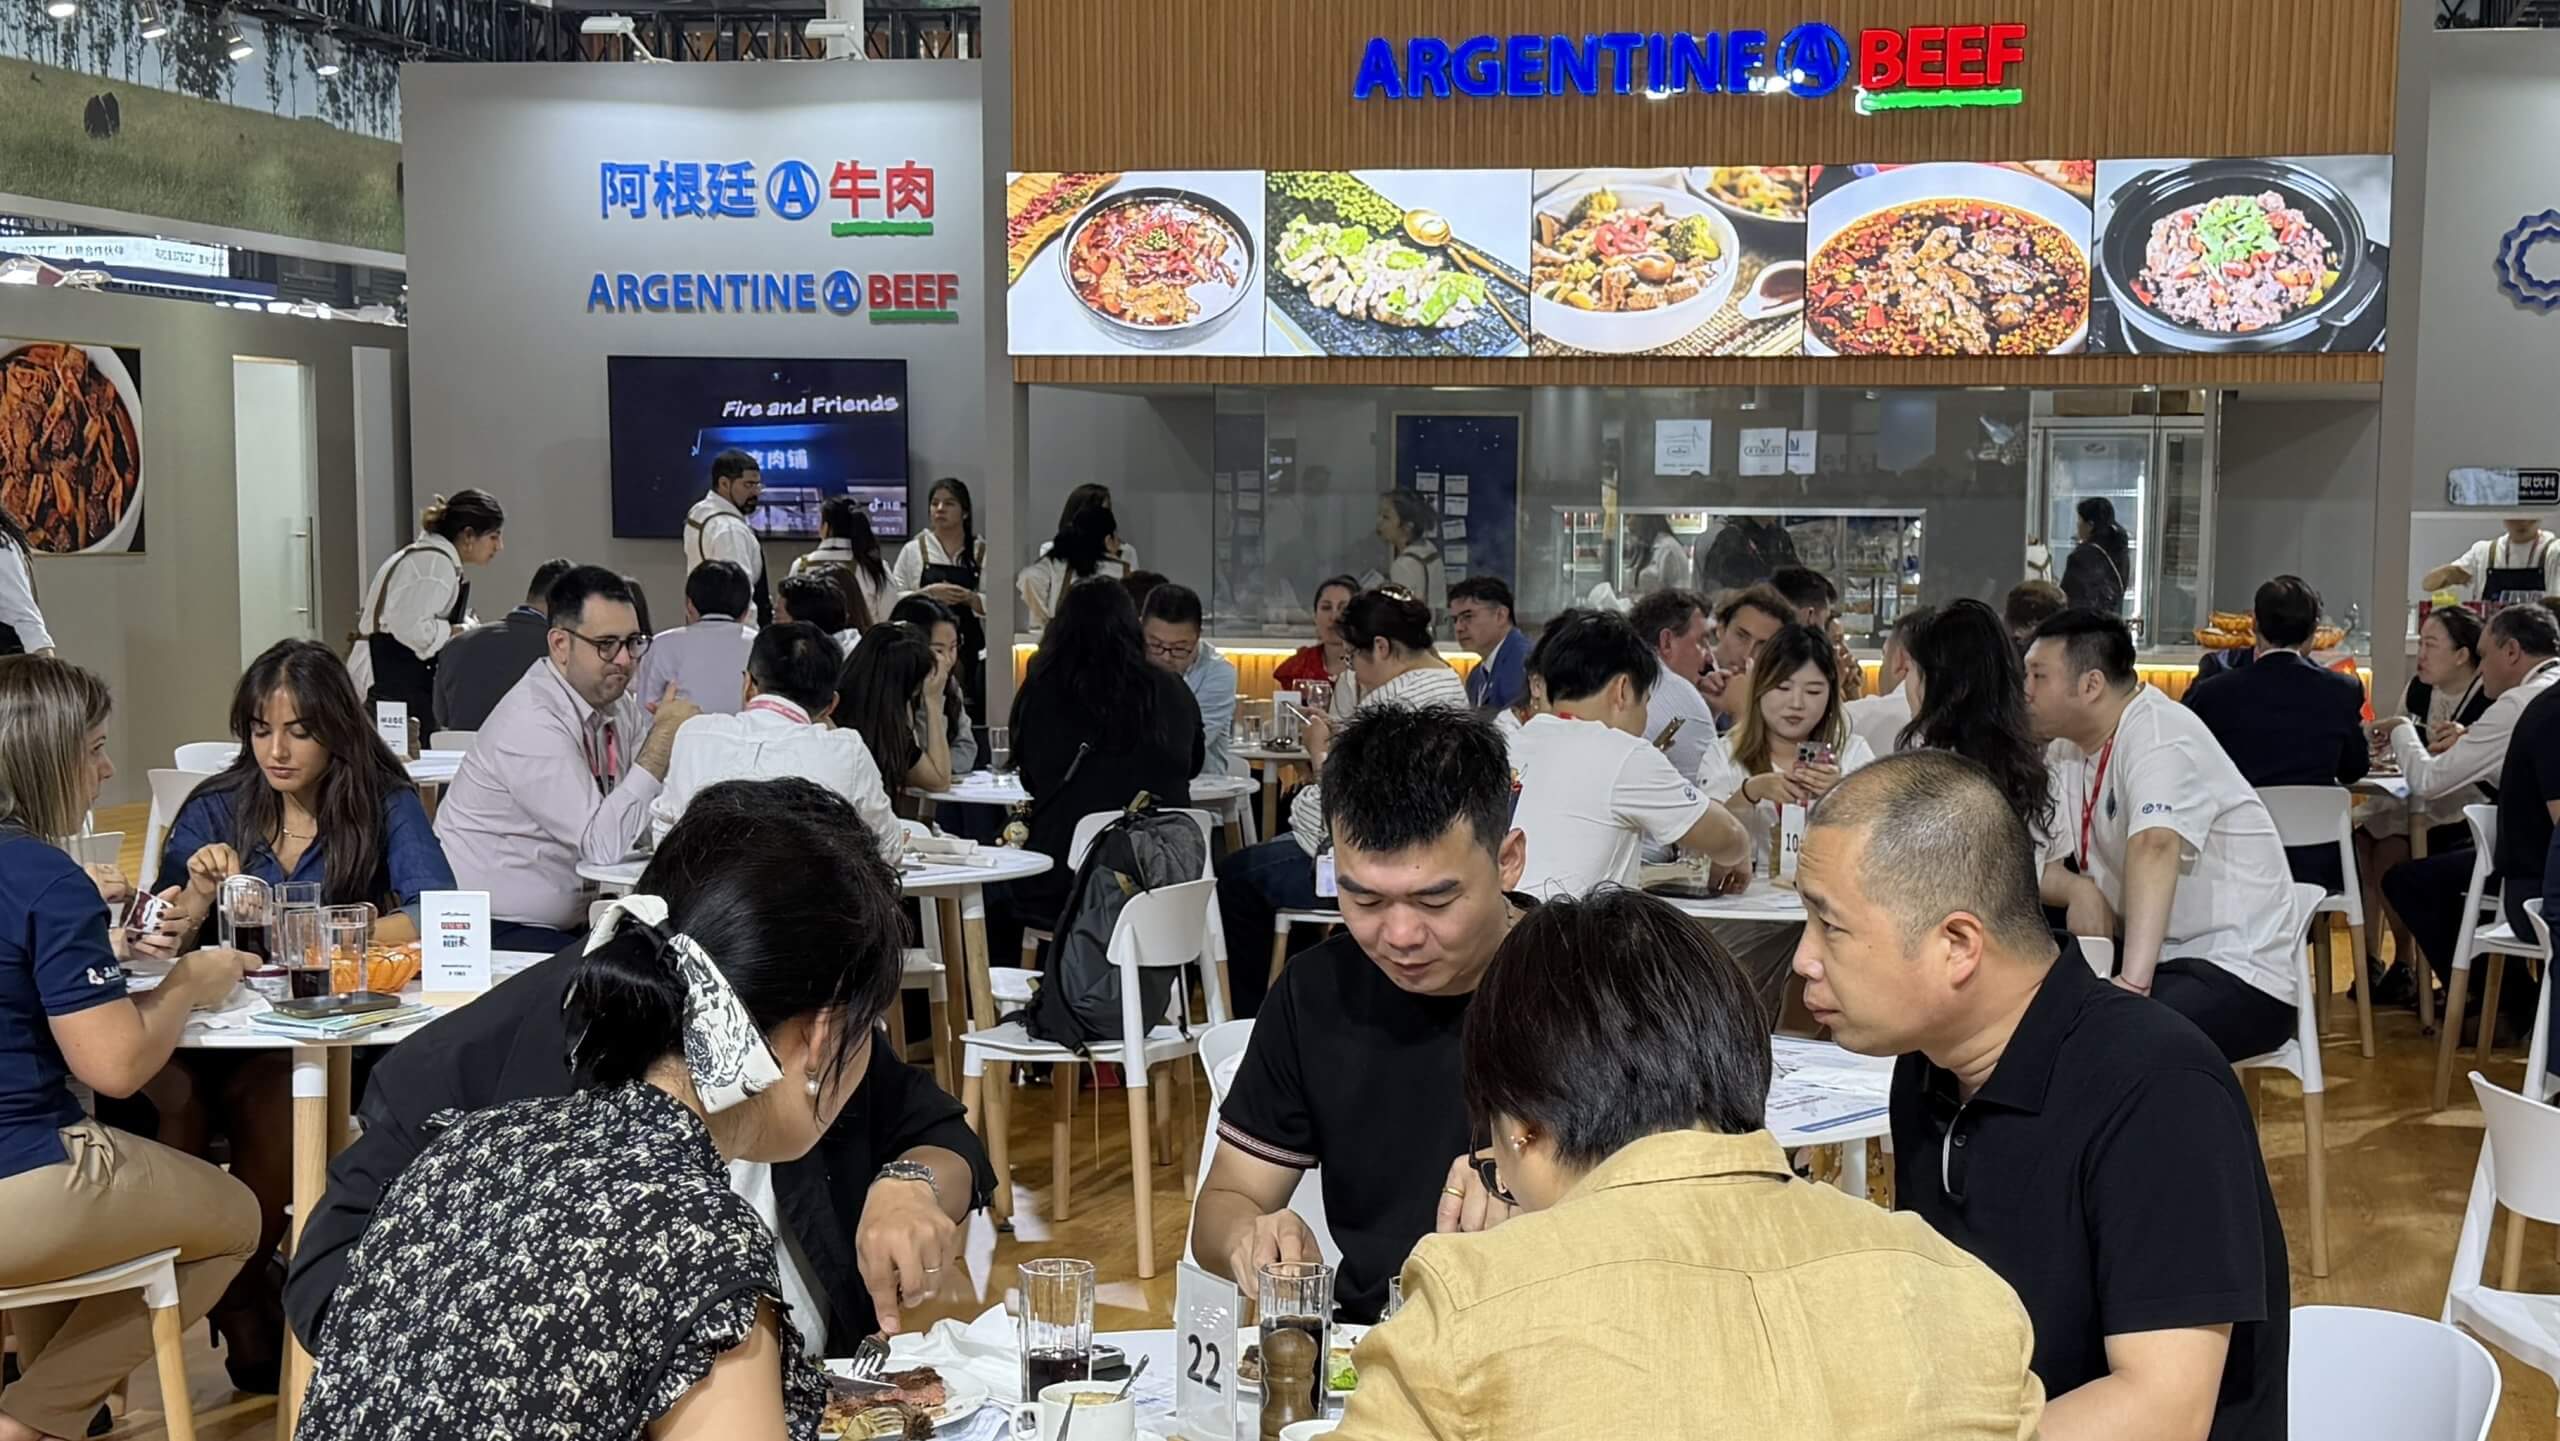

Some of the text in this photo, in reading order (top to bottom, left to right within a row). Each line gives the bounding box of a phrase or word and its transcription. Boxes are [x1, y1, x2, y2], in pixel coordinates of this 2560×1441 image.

[1353, 31, 1768, 99] ARGENTINE
[1859, 24, 2027, 90] BEEF
[601, 160, 759, 220] 阿根廷
[830, 159, 934, 219] 牛肉
[588, 273, 816, 313] ARGENTINE
[868, 274, 959, 311] BEEF
[722, 394, 899, 418] Fire and Friends
[1785, 833, 1799, 853] 10
[1187, 1333, 1222, 1394] 22
